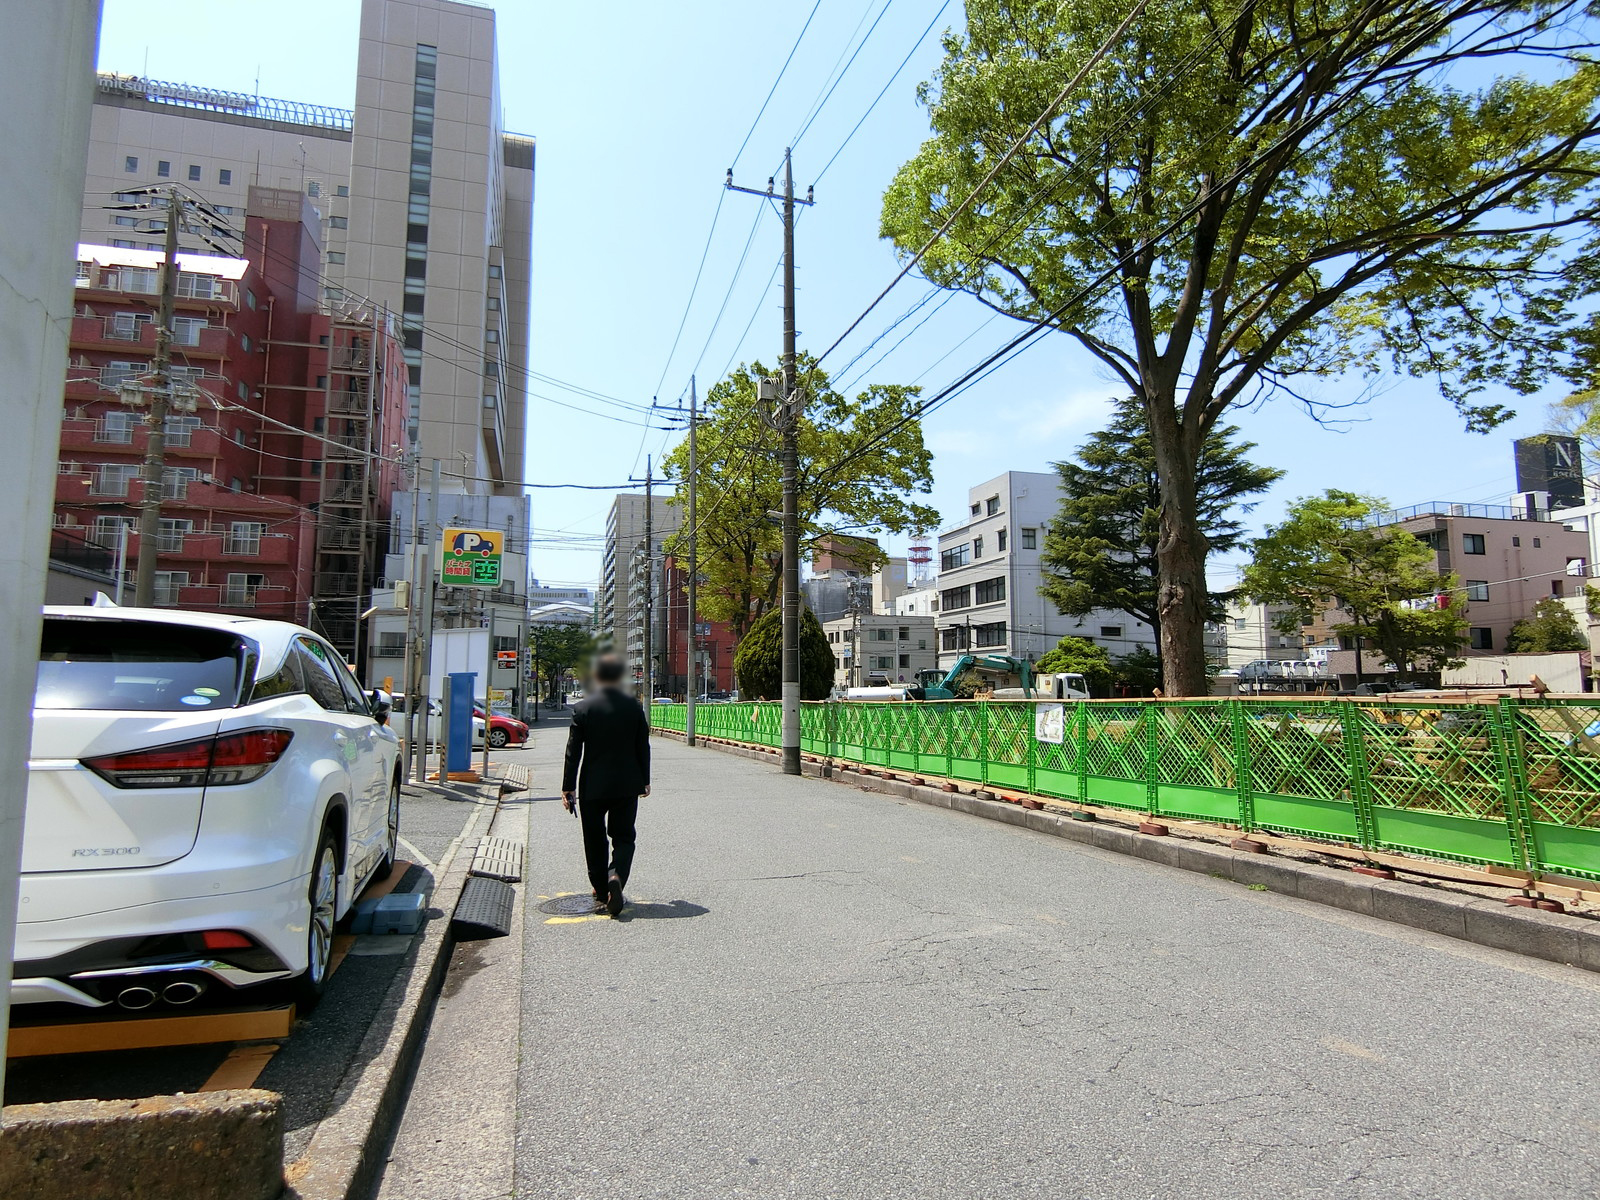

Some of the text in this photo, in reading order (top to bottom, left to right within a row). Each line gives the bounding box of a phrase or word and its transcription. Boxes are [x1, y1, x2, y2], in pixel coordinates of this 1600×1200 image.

[1553, 442, 1572, 467] N
[464, 534, 481, 551] P
[72, 846, 140, 857] RX 300
